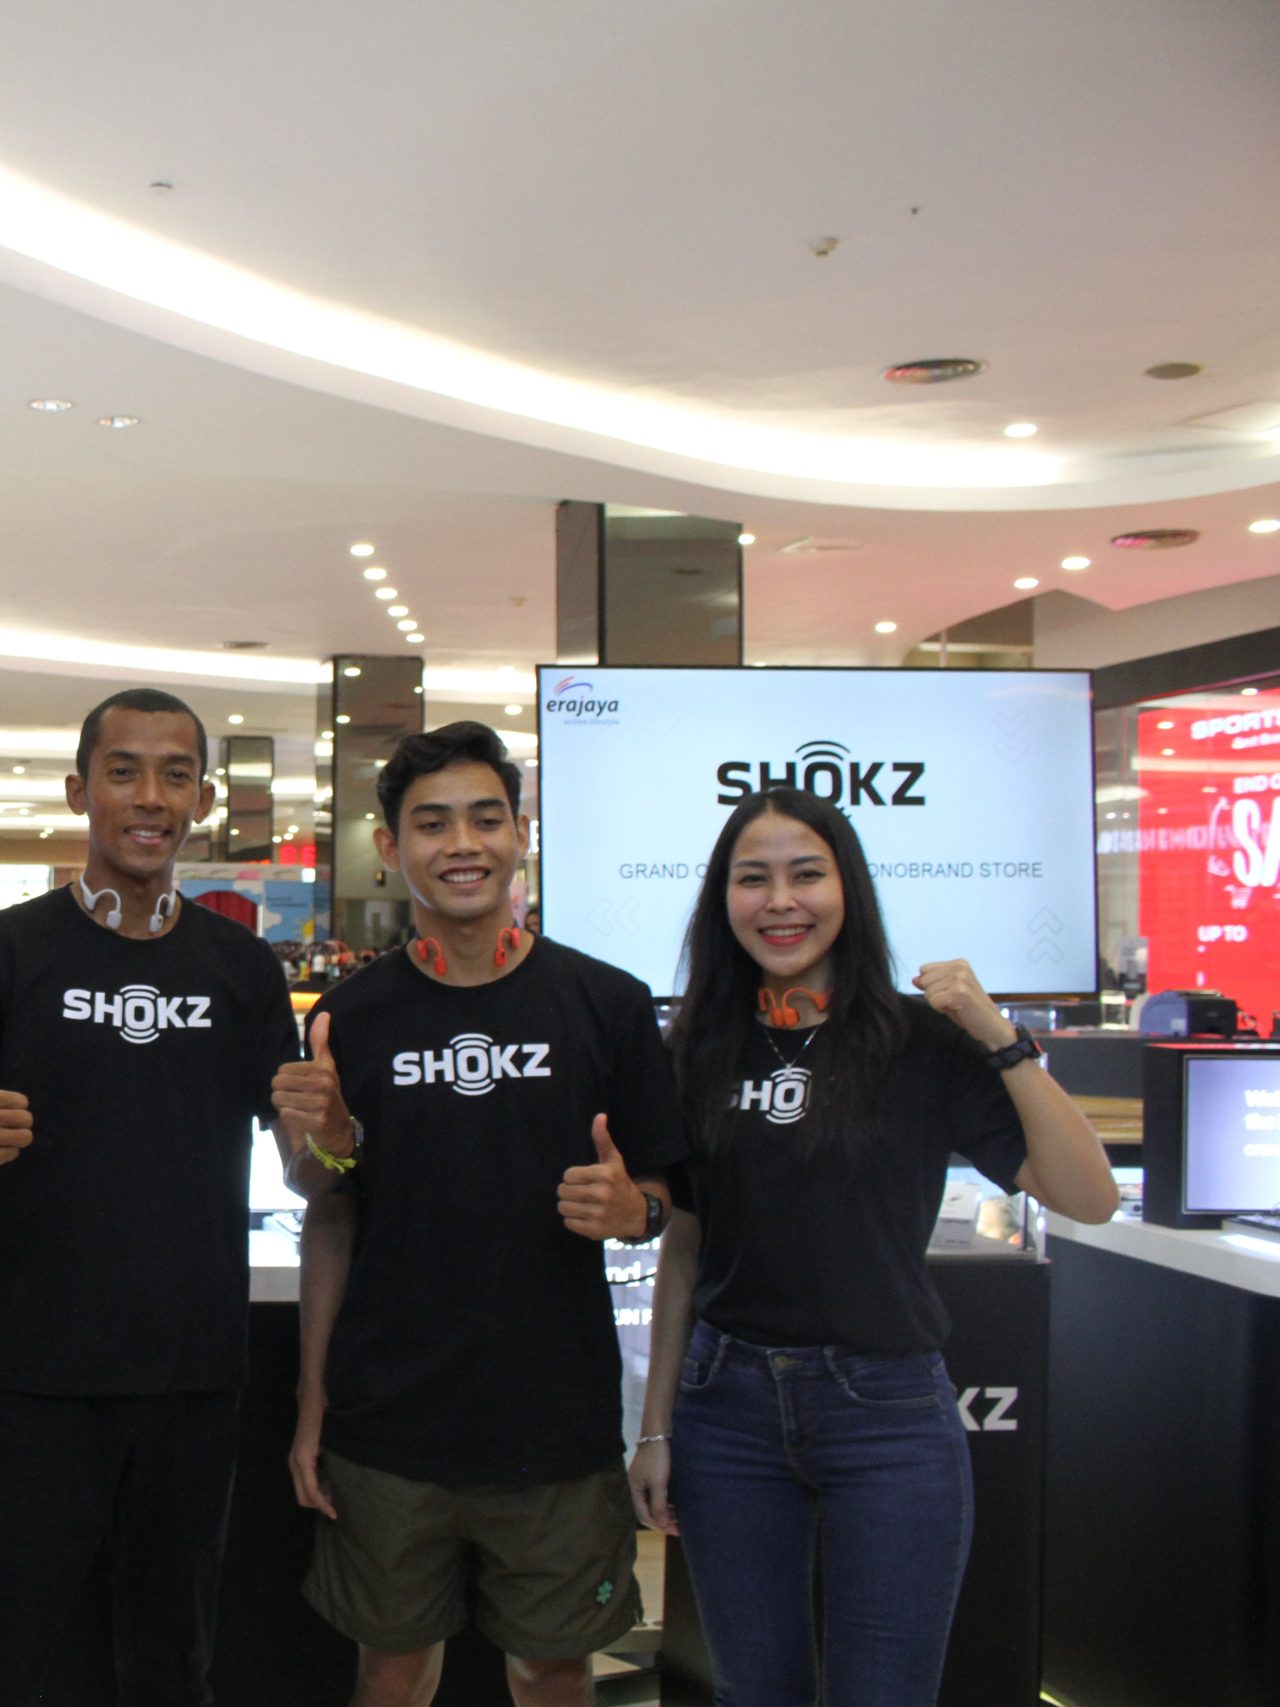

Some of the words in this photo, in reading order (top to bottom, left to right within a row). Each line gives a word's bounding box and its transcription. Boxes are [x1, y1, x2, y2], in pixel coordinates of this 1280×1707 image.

[546, 696, 619, 717] erajaya
[1190, 709, 1280, 739] SPORT
[716, 760, 926, 806] SHOKZ
[620, 863, 689, 879] GRAND
[867, 862, 973, 878] ONOBRAND
[979, 862, 1043, 877] STORE
[63, 987, 212, 1031] SHOKZ
[392, 1042, 552, 1088] SHOKZ
